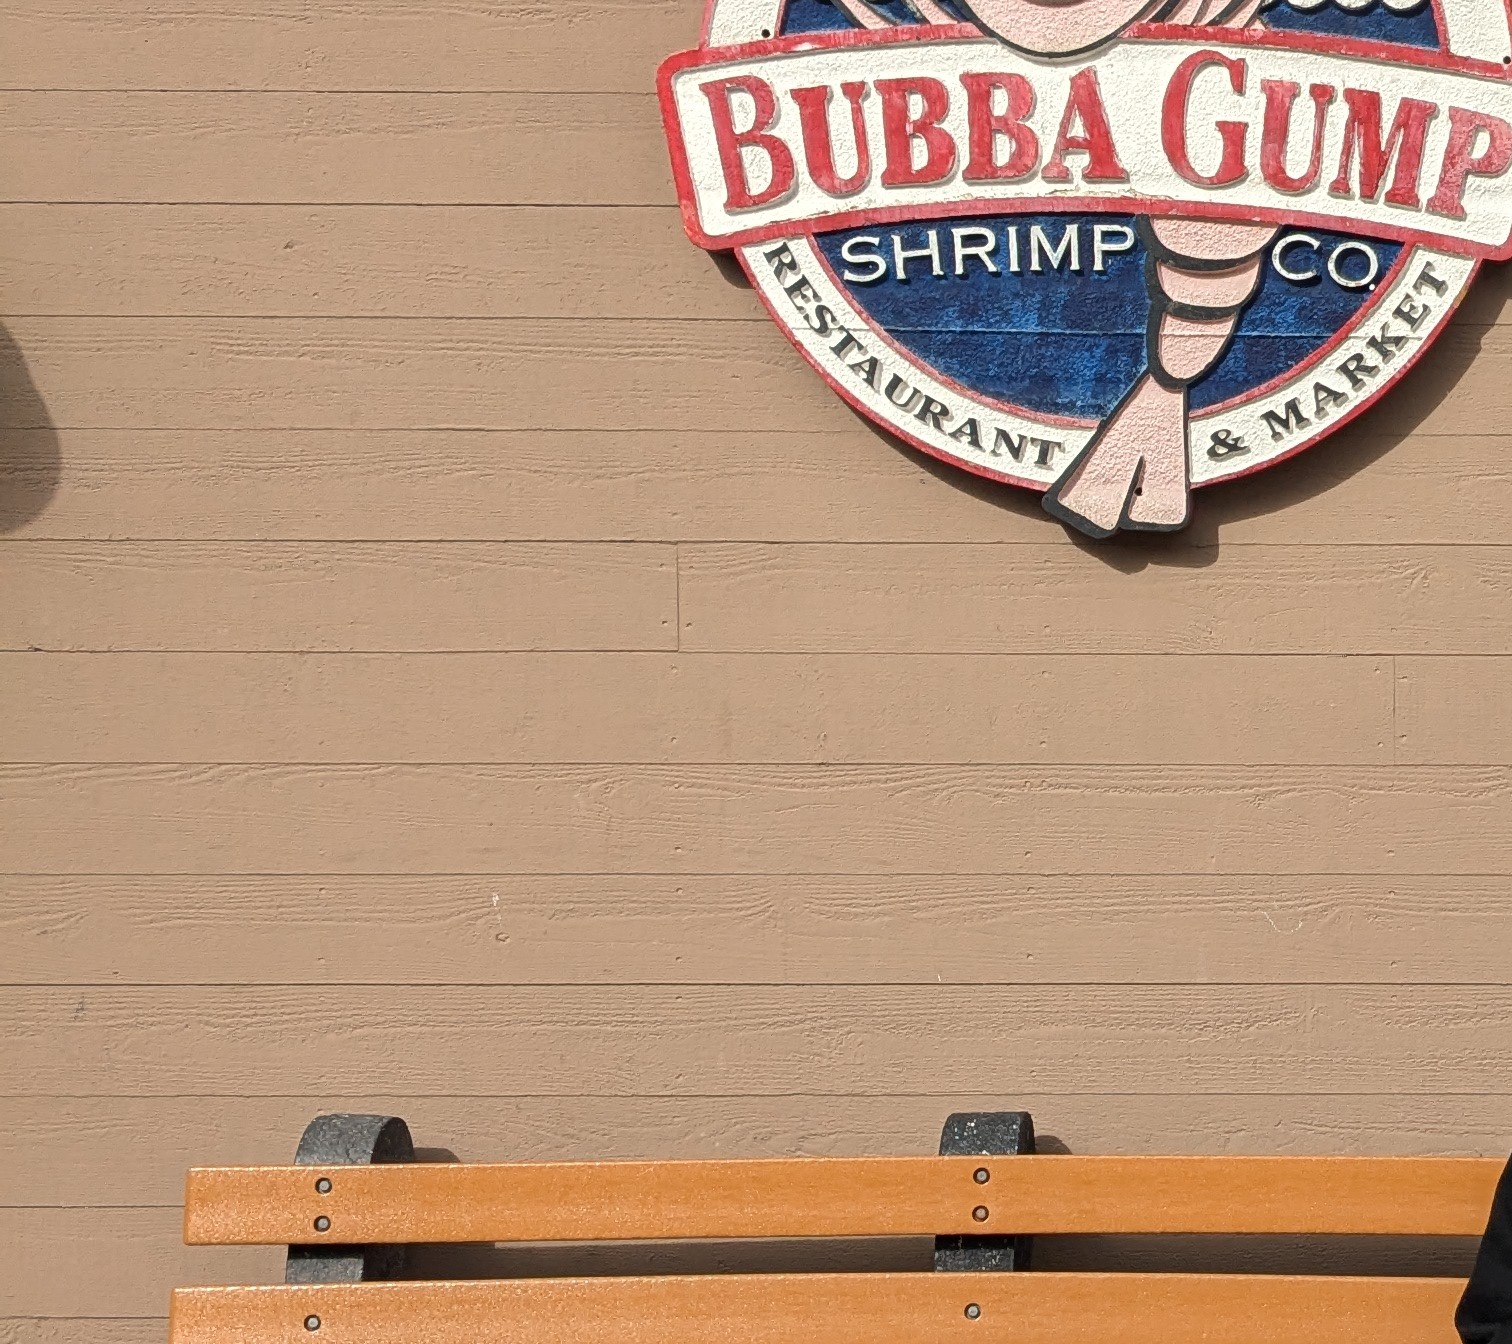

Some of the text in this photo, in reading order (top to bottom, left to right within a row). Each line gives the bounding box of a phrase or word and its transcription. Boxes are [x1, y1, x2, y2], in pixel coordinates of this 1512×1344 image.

[698, 64, 1130, 213] BUBBA
[841, 224, 1138, 283] SHRIMP
[762, 240, 1449, 470] RESTAURANT & MARKET
